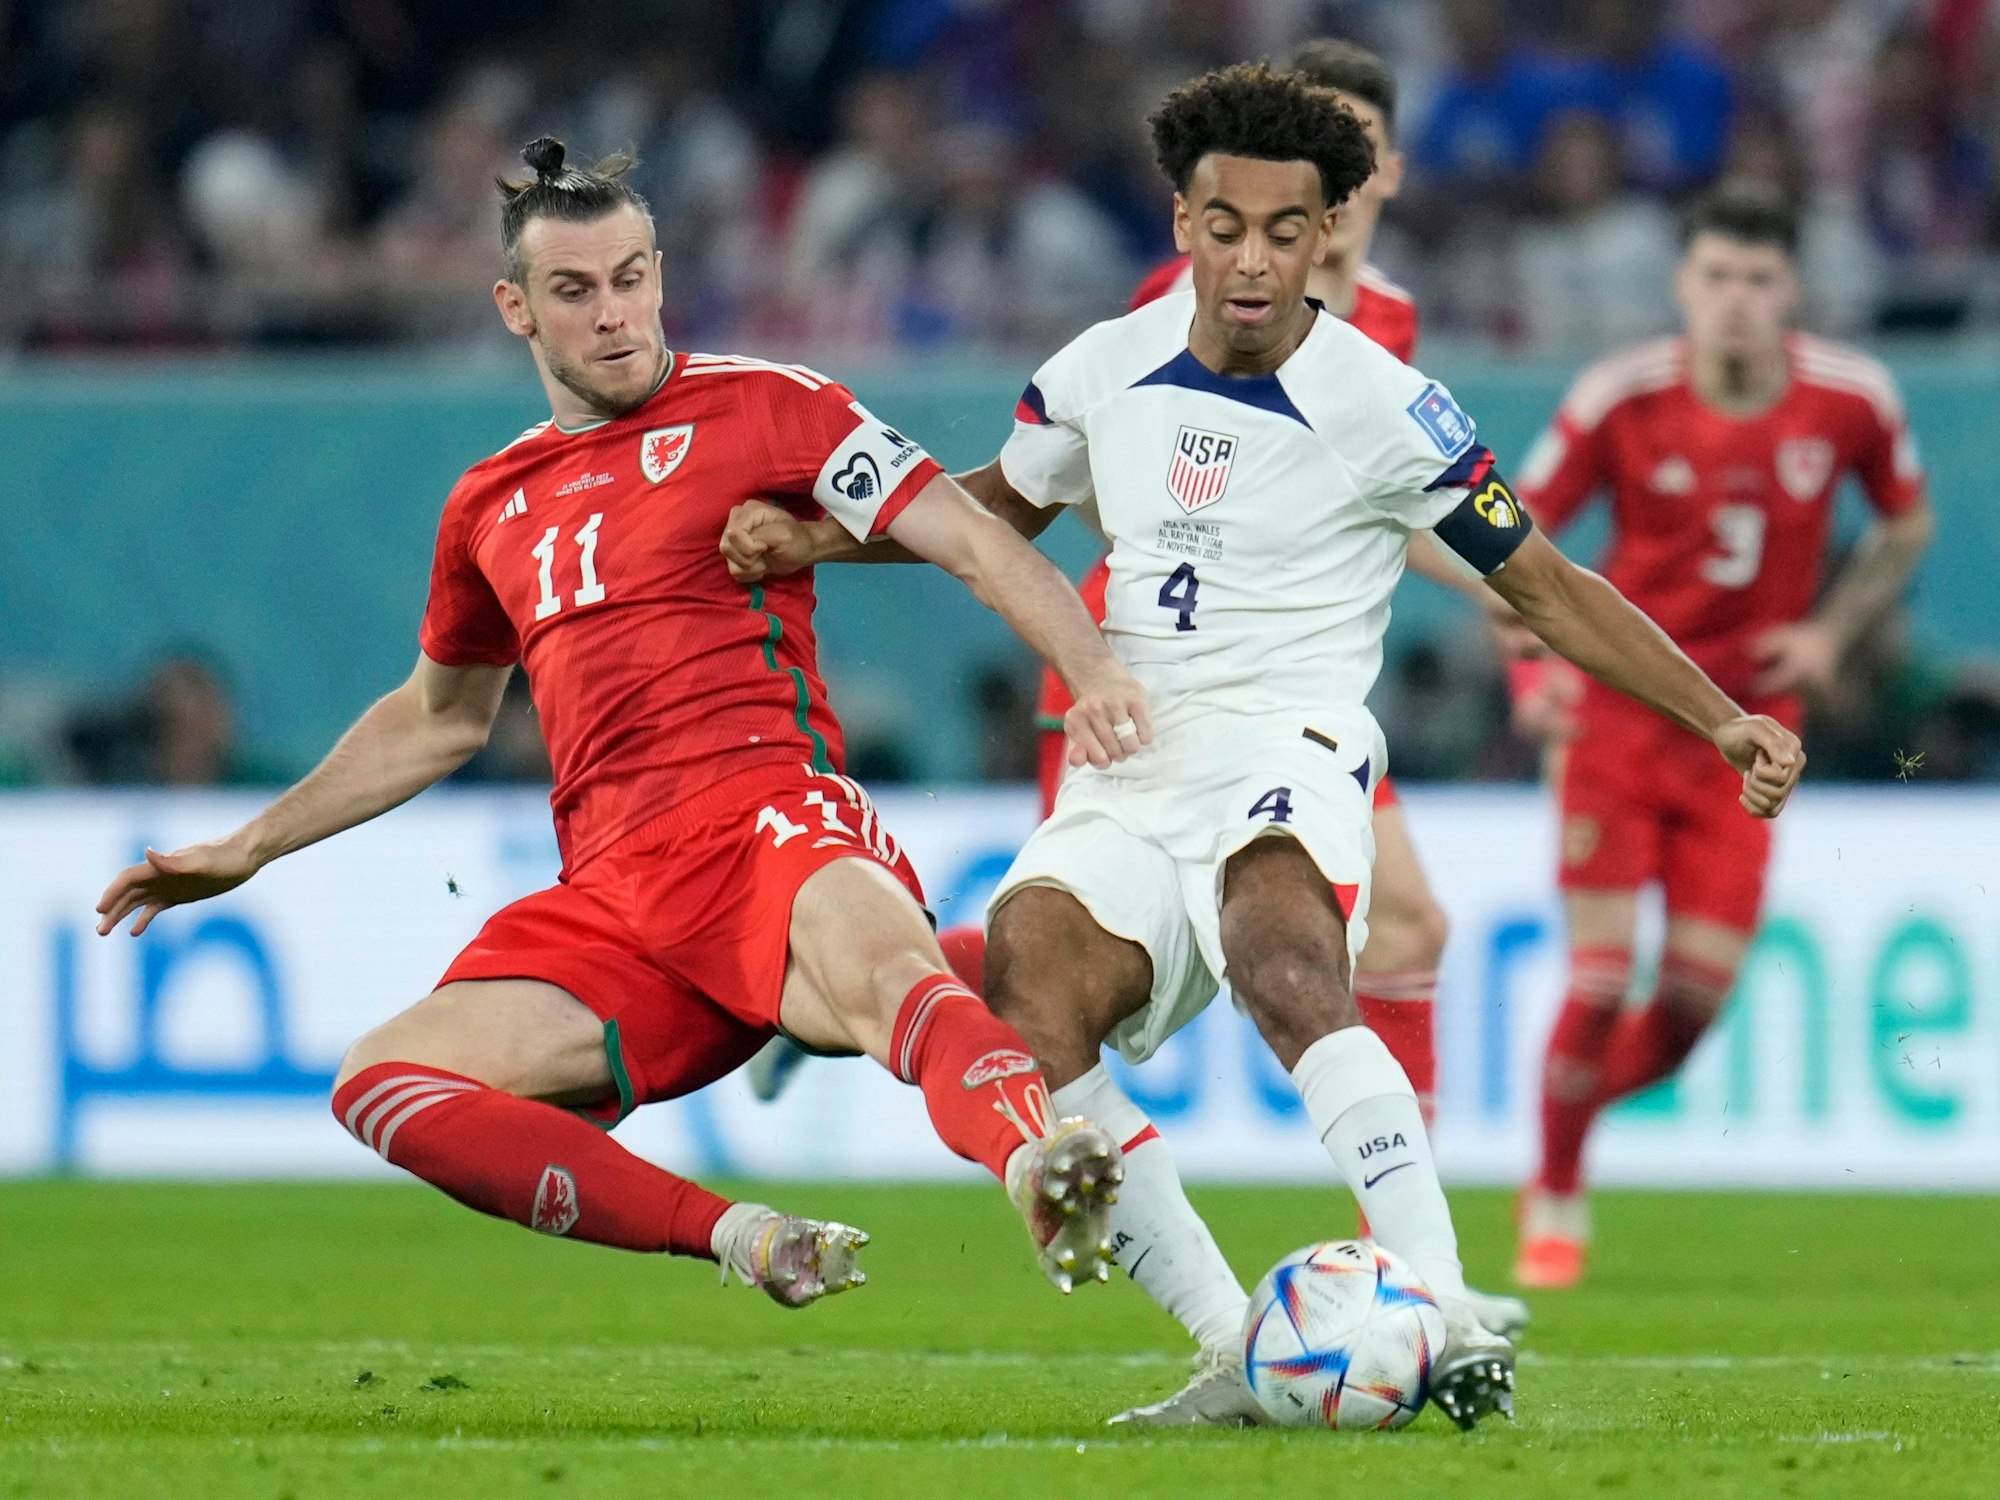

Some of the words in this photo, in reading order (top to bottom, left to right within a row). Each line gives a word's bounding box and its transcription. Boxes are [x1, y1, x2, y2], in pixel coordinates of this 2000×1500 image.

[1180, 431, 1233, 466] USA
[1158, 528, 1169, 539] AL
[1162, 519, 1179, 530] USA
[1194, 523, 1221, 537] WALES
[1156, 538, 1166, 550] 21
[1203, 548, 1224, 562] 2022
[1702, 505, 1765, 587] 3
[530, 511, 606, 622] 11
[1158, 562, 1199, 632] 4
[1248, 786, 1294, 824] 4
[1358, 1132, 1408, 1160] USA
